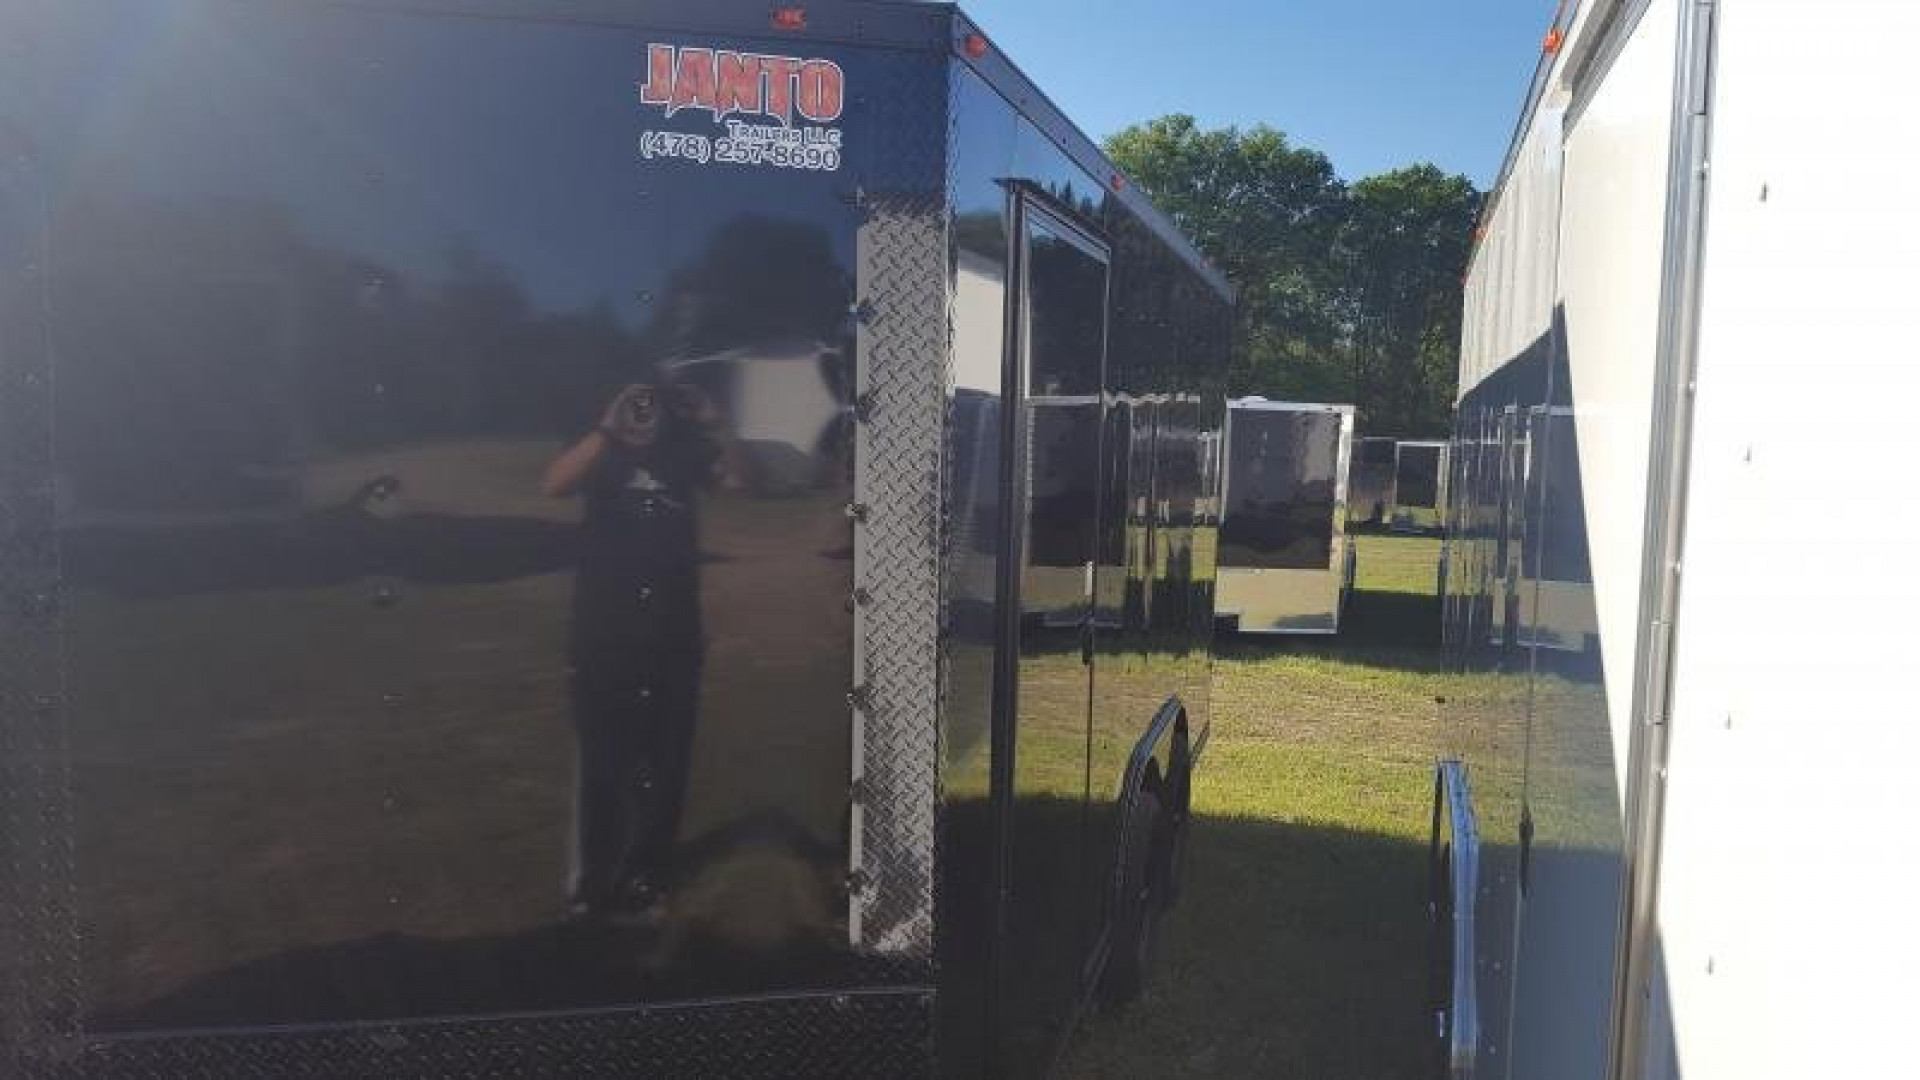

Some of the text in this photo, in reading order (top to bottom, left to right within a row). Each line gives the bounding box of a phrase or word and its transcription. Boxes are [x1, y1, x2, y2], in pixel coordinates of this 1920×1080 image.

[641, 43, 844, 123] JANTO
[641, 131, 841, 171] (478) 257-8690
[804, 126, 843, 147] LLC
